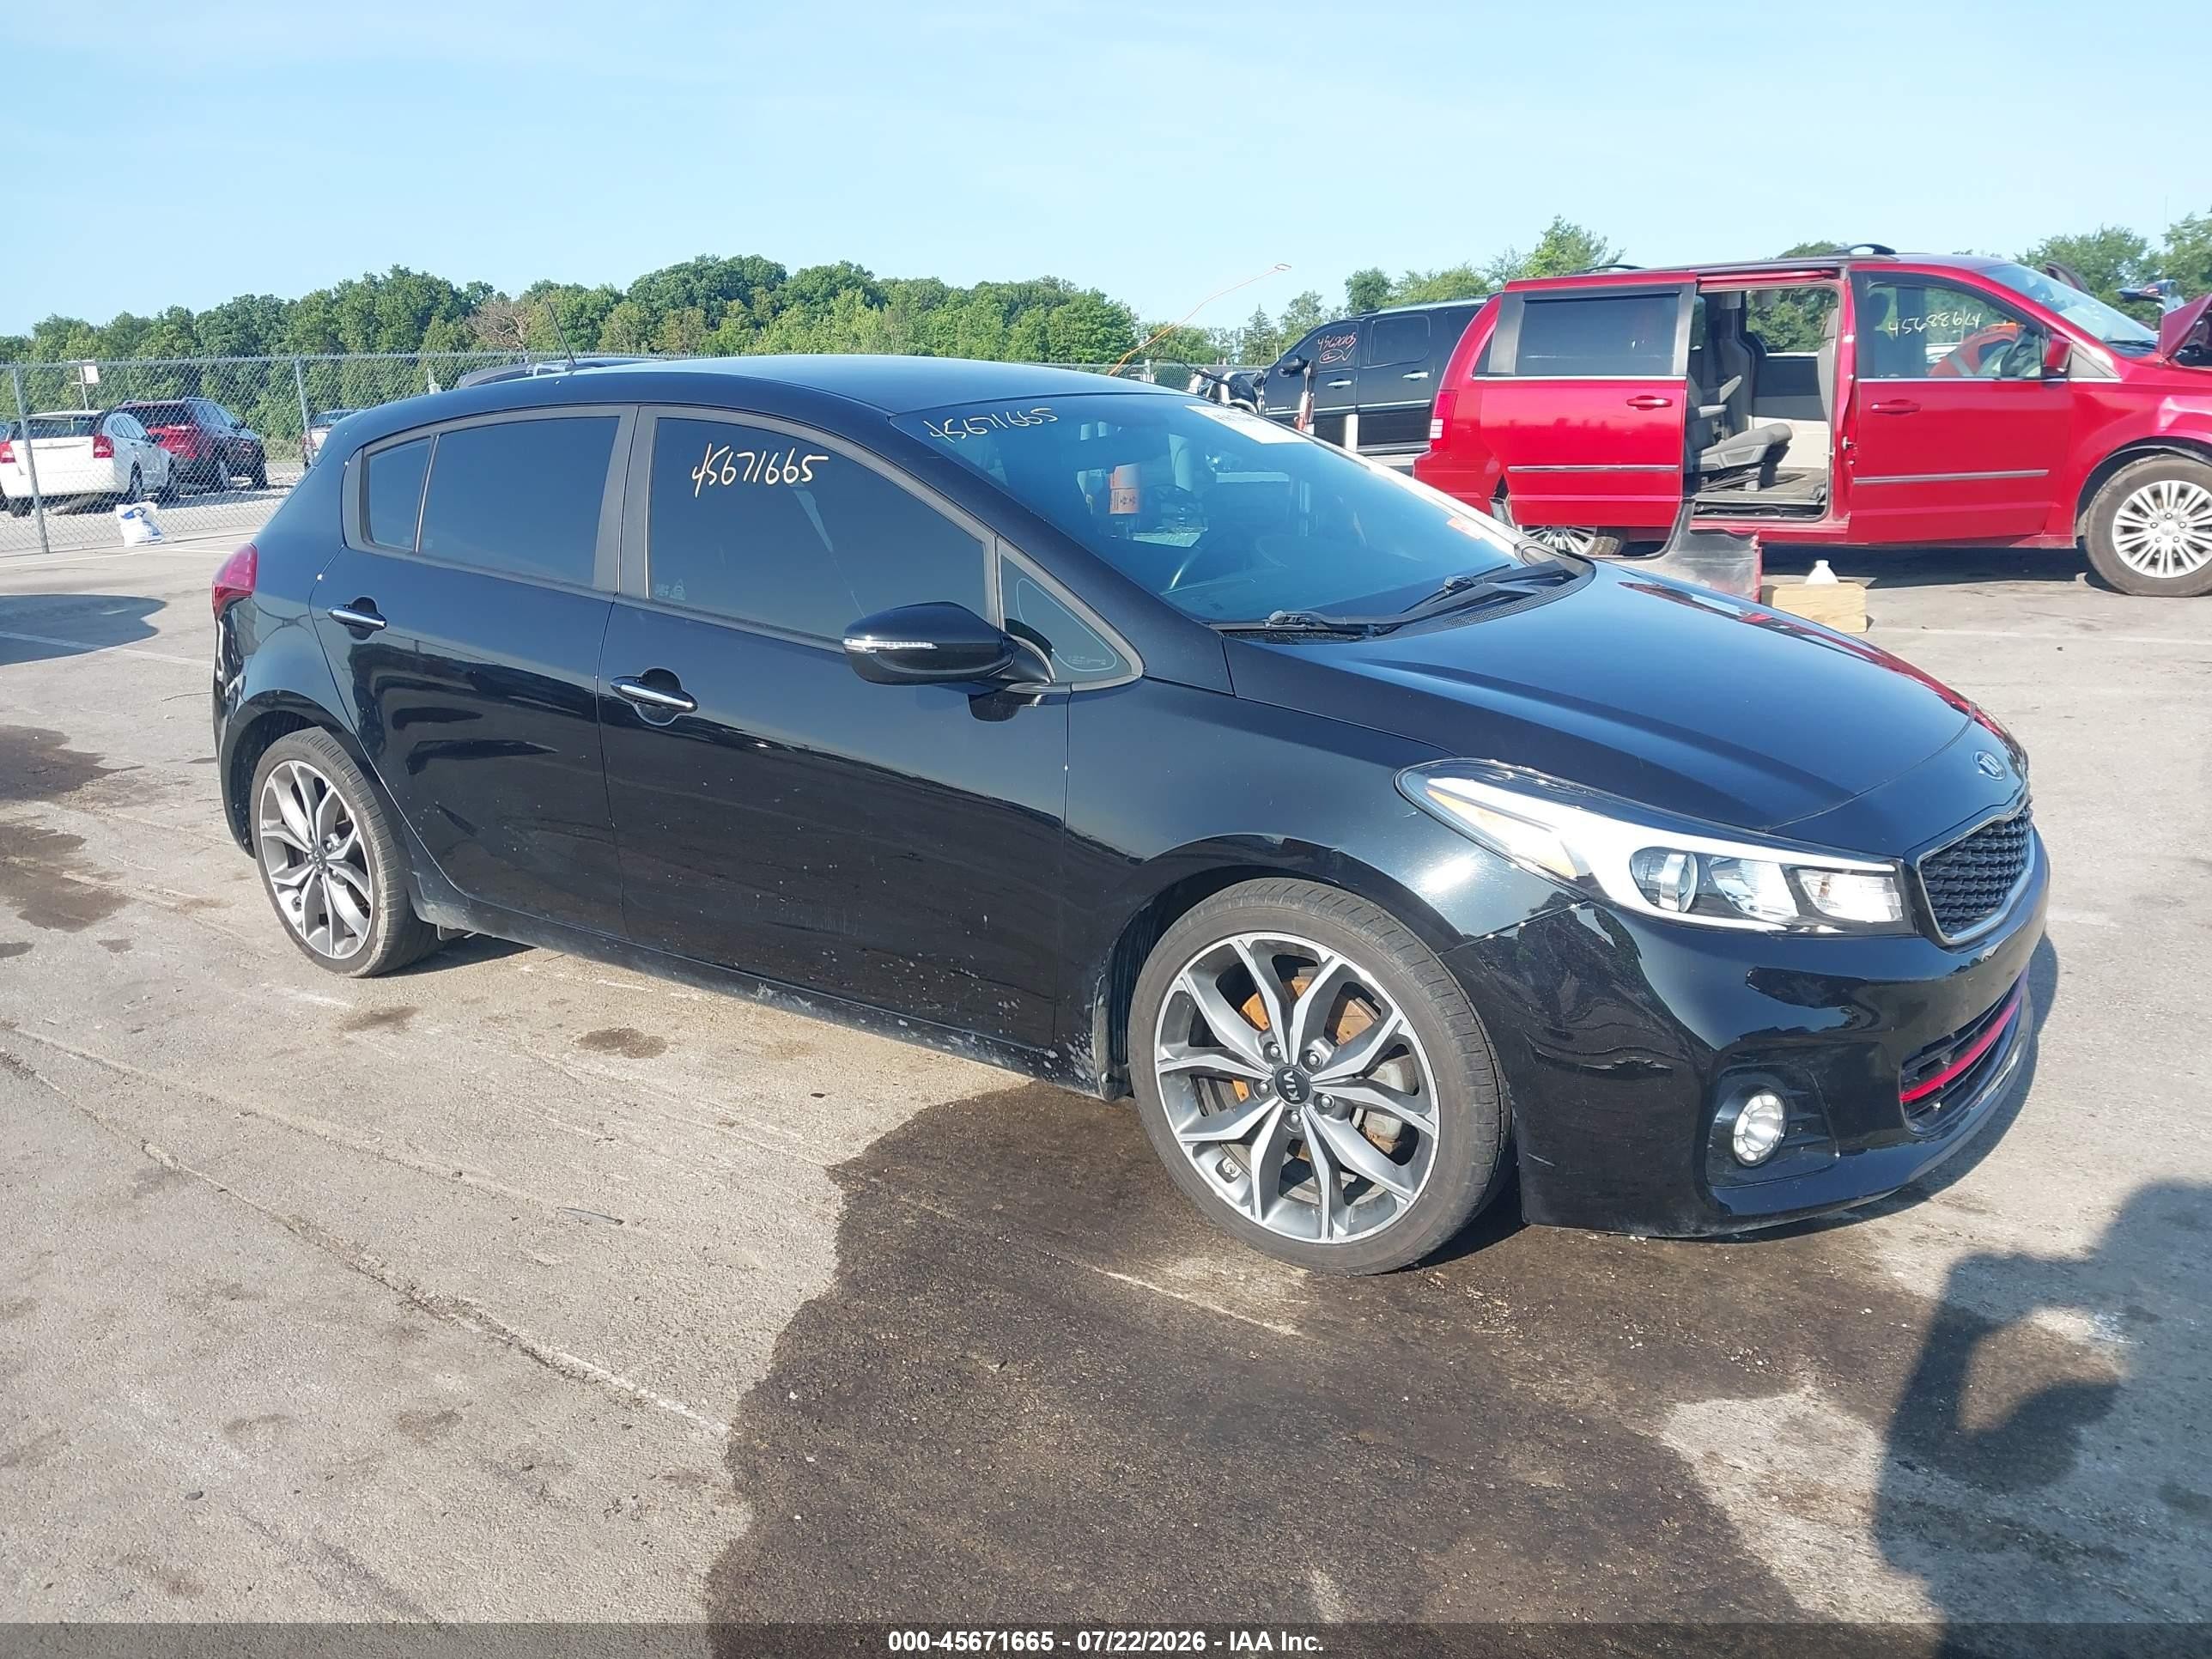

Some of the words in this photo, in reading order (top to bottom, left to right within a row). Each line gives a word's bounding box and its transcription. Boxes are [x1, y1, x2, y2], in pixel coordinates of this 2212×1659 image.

[923, 407, 1059, 444] 45671665
[691, 442, 830, 498] 45671665
[1283, 1070, 1301, 1101] KIA
